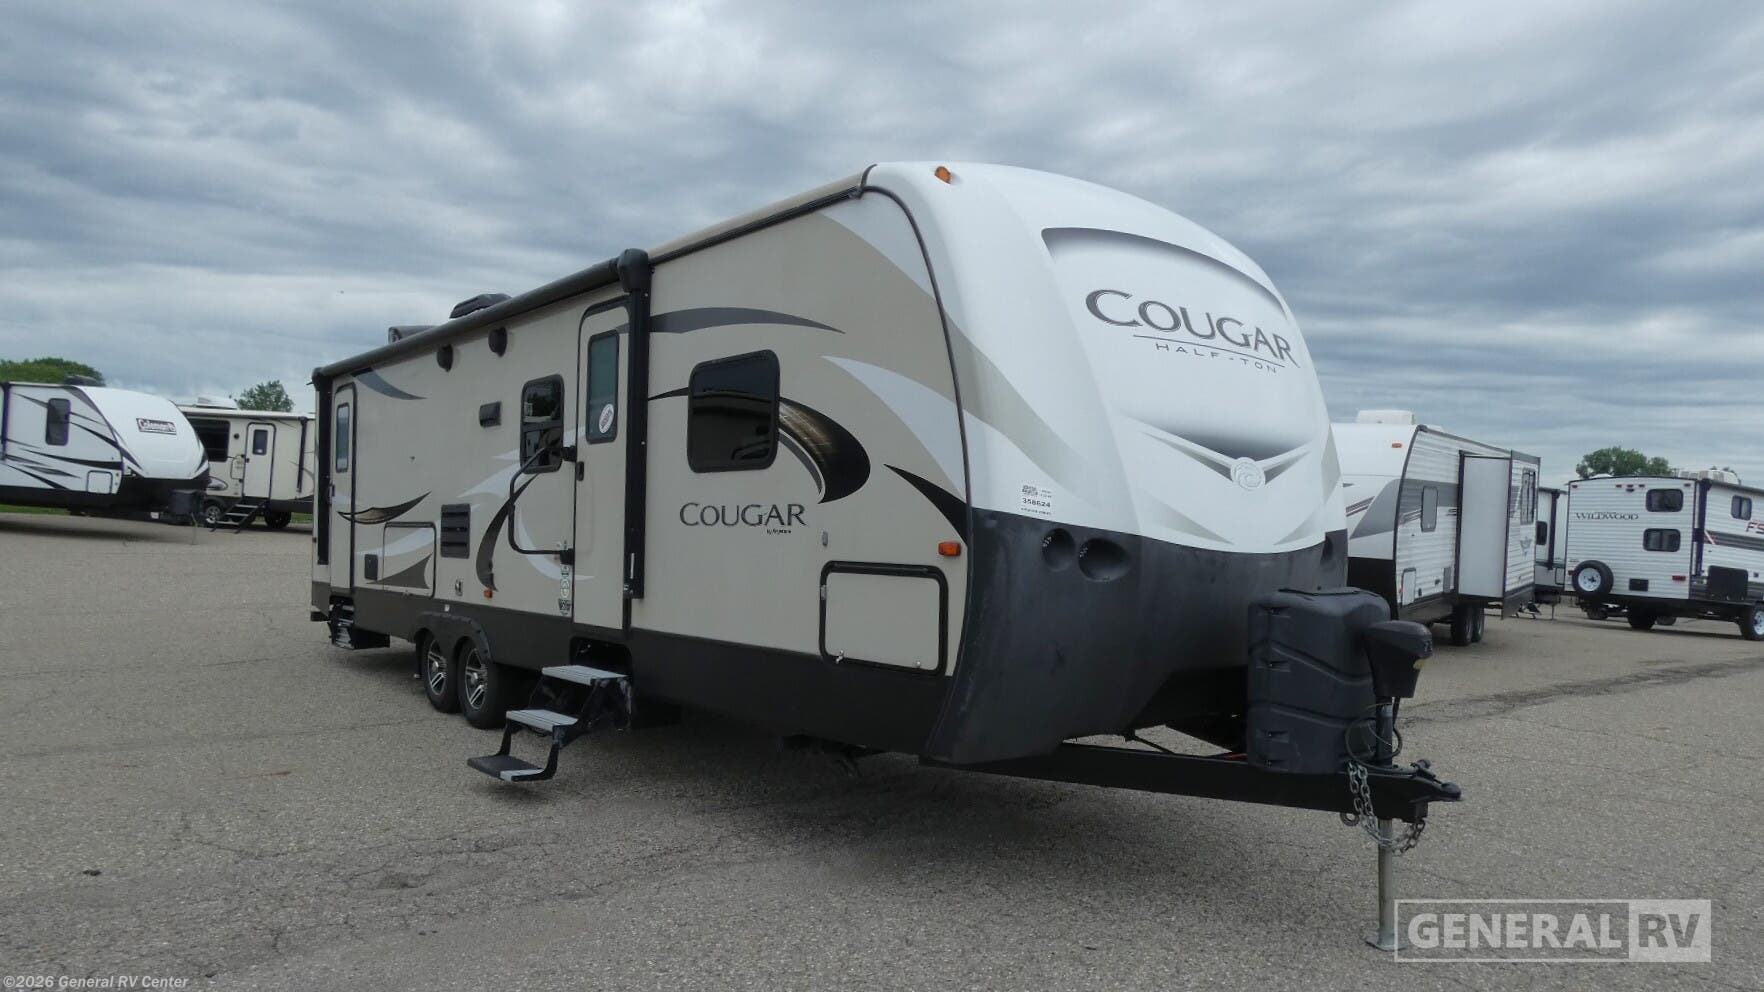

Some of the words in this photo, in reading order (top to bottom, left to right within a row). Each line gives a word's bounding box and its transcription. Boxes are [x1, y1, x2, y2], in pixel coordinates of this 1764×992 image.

[1086, 289, 1301, 368] COUGAR
[1155, 342, 1277, 374] HALF-TON
[680, 502, 807, 527] COUGAR
[1575, 511, 1640, 521] WILDWOOD
